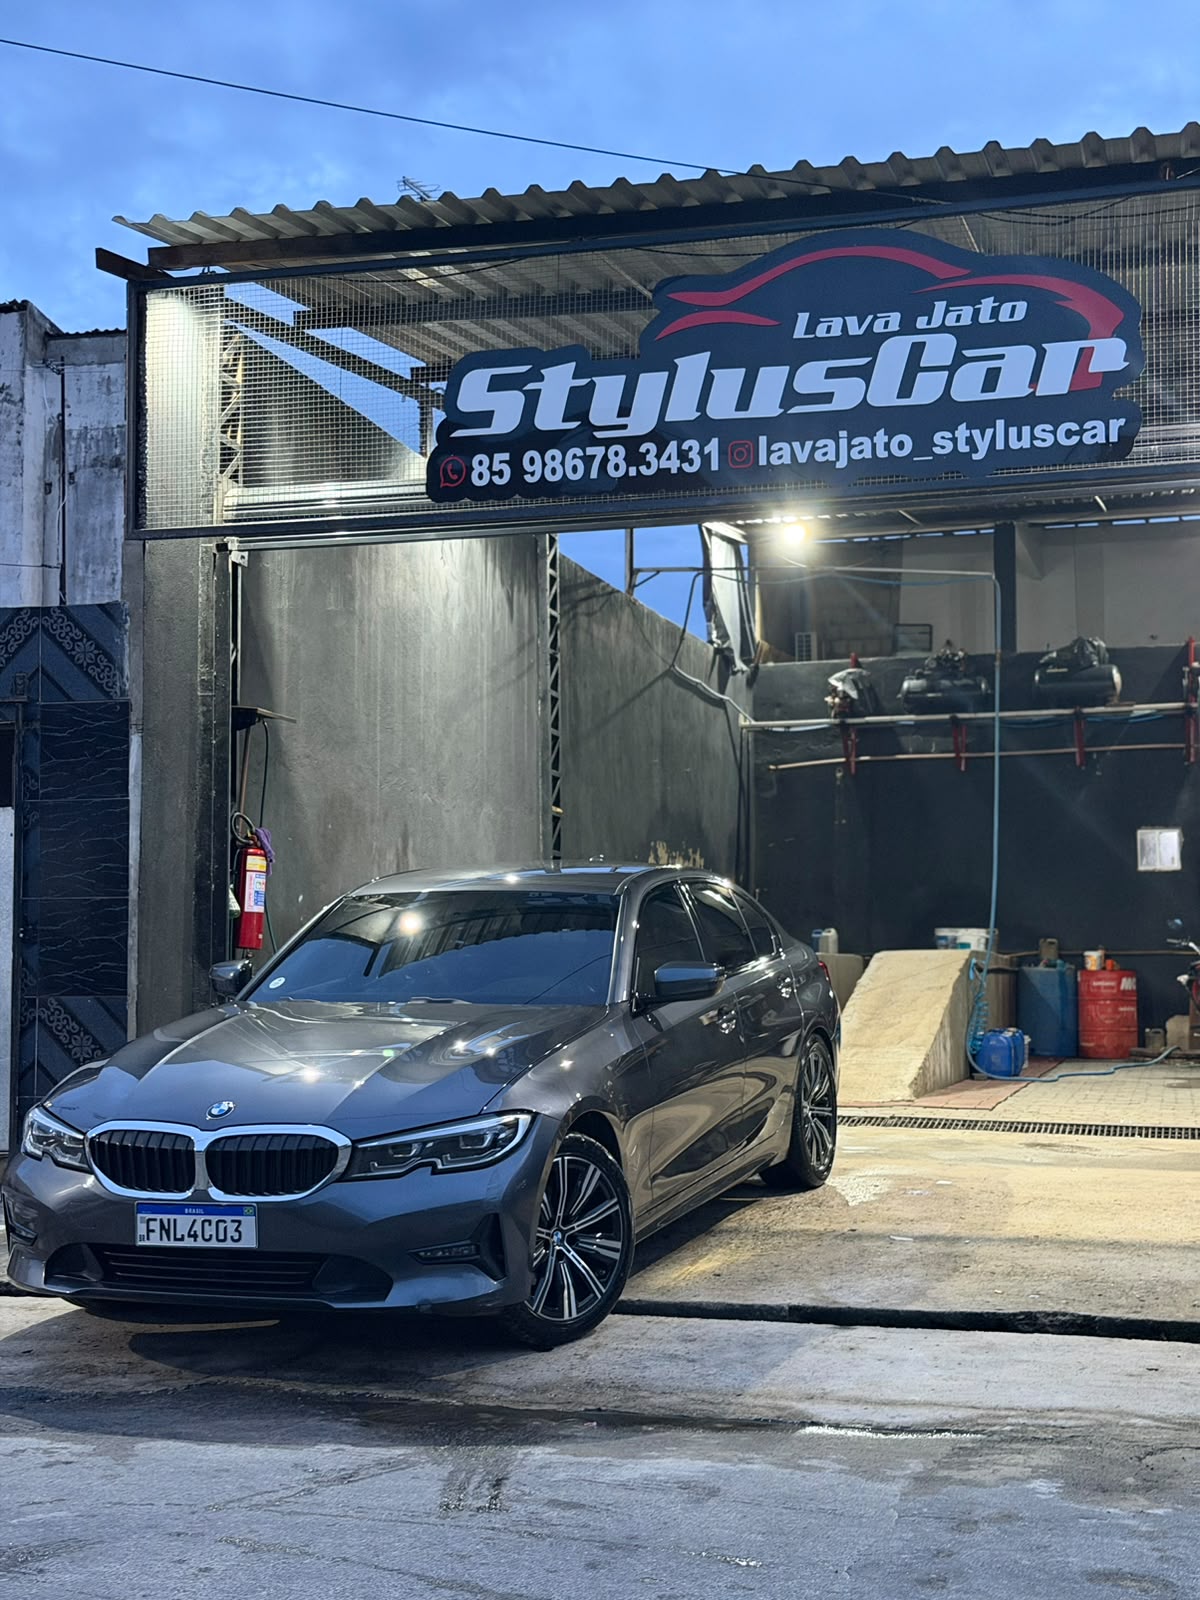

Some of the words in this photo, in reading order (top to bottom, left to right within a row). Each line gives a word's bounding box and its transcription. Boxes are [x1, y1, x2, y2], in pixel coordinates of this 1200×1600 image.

[793, 311, 901, 339] Lava
[915, 296, 1028, 330] Jato
[449, 332, 1131, 439] StylusCar
[470, 453, 511, 487] 85
[522, 437, 719, 484] 98678.3431
[758, 417, 1127, 469] lavajato_styluscar
[145, 1217, 243, 1243] FNL4C03
